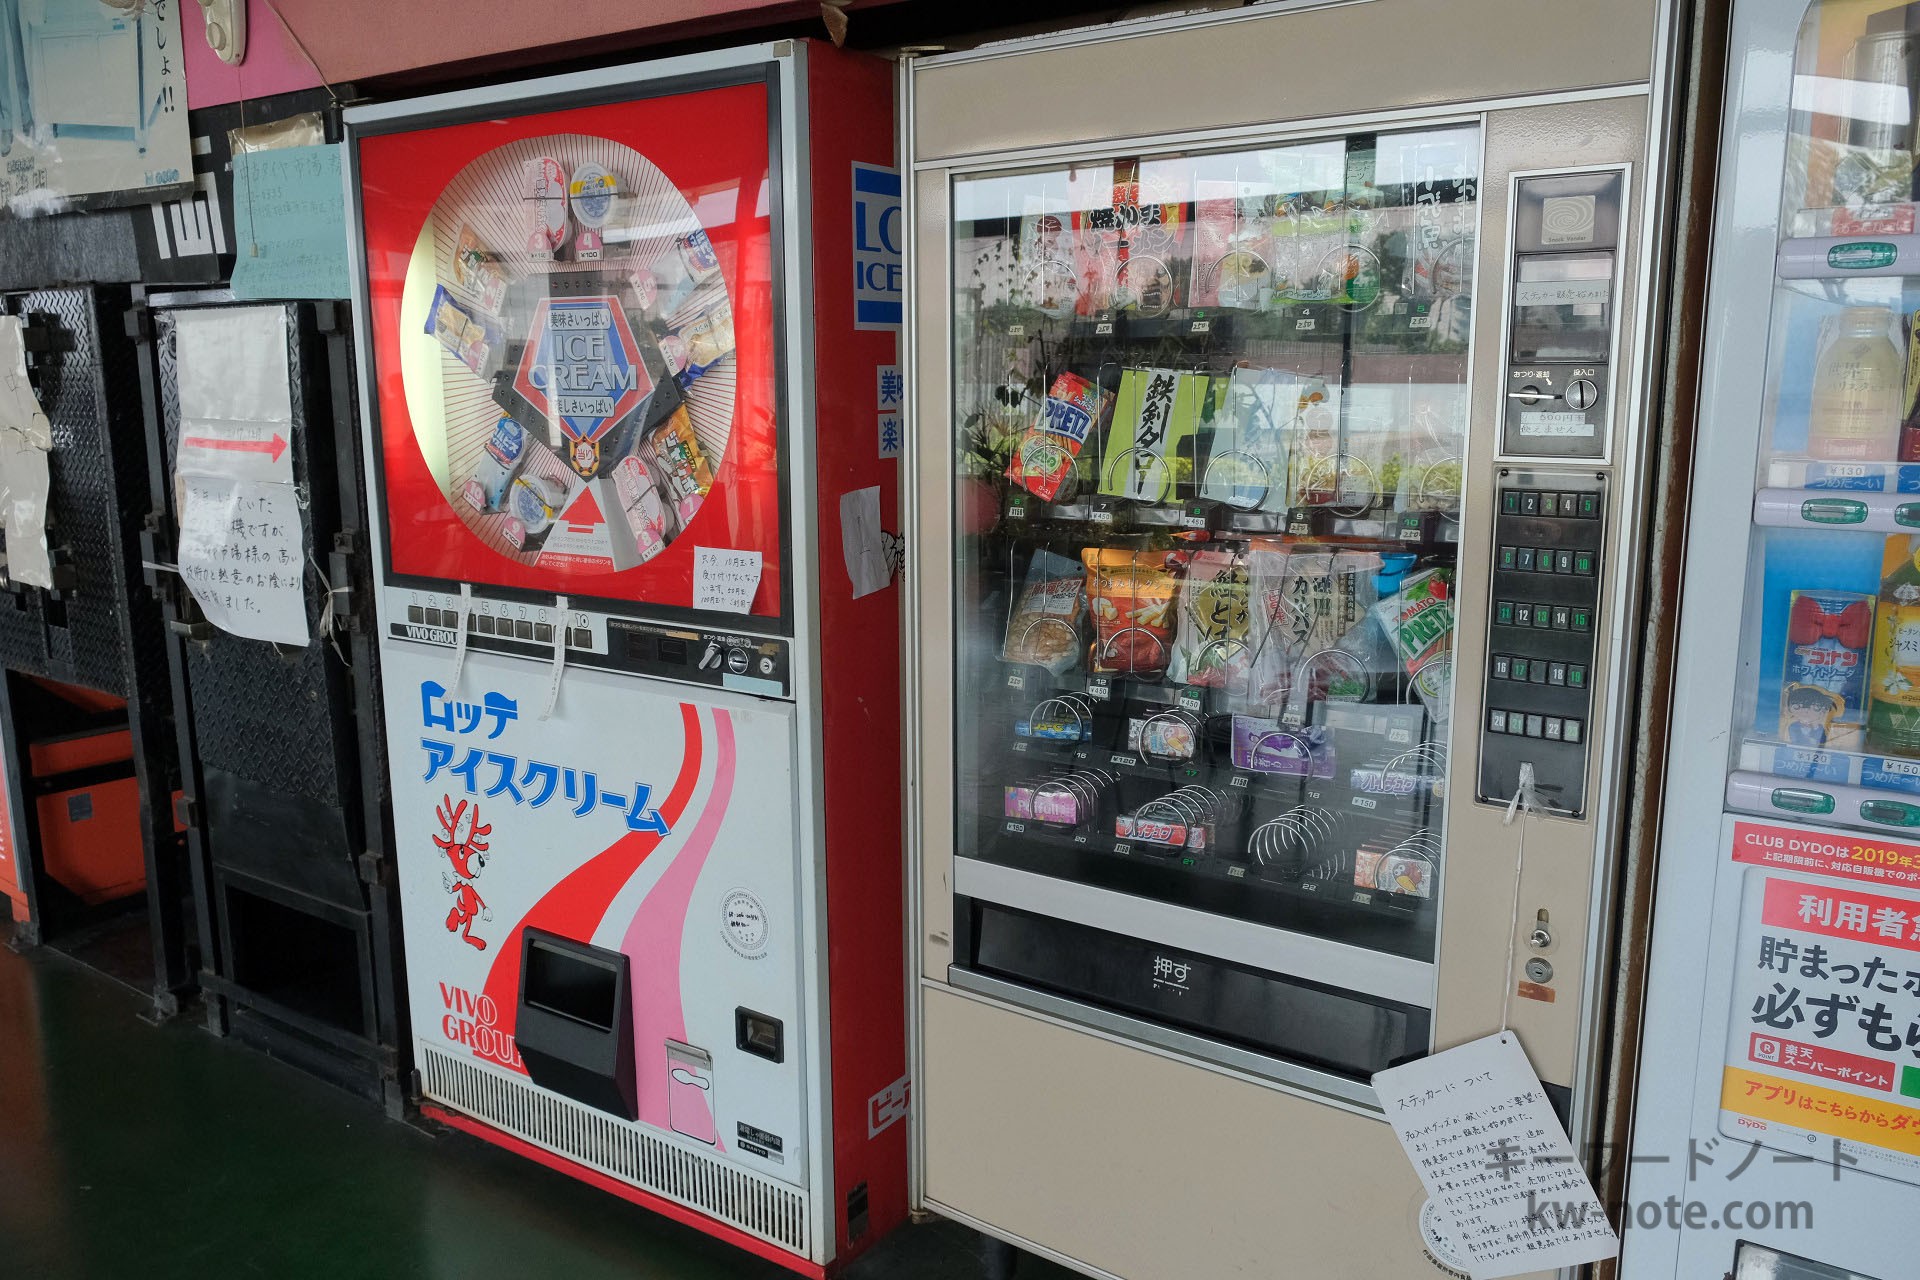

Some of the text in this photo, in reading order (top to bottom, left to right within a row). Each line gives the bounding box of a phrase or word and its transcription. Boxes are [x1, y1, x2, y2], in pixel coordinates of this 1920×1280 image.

[583, 232, 593, 248] 4
[551, 311, 611, 328] 美味さいっぱい
[555, 335, 606, 362] ICE
[528, 363, 638, 391] CREAM
[1573, 368, 1595, 376] 投入口
[1044, 399, 1090, 439] PRETZ
[1830, 466, 1863, 476] ¥130
[685, 497, 695, 513] 7
[1508, 497, 1591, 511] 1 2 3 4 5
[1093, 513, 1111, 521] ¥450
[1186, 518, 1204, 527] ¥450
[1404, 519, 1418, 527] 10
[1504, 553, 1511, 564] 6
[1524, 554, 1530, 565] 7
[1561, 557, 1567, 568] 9
[1578, 559, 1588, 570] 10
[428, 595, 437, 607] 2
[446, 597, 454, 609] 3
[481, 602, 490, 615] 5
[501, 604, 509, 617] 6
[519, 606, 527, 619] 7
[538, 608, 547, 622] 8
[575, 613, 590, 628] 10
[1392, 597, 1437, 623] TOMATO
[1501, 608, 1585, 625] 11 12 13 14 15
[406, 626, 429, 639] VIVO
[1807, 650, 1859, 667] コナン
[1497, 662, 1506, 673] 16
[1554, 669, 1563, 680] 18
[1792, 664, 1855, 678] ホワイトソーダ
[1090, 687, 1107, 696] ¥450
[1188, 690, 1199, 698] 13
[420, 680, 519, 739] ロッテ
[1180, 699, 1199, 708] ¥450
[1494, 716, 1504, 727] 20
[1549, 724, 1559, 735] 22
[1797, 752, 1828, 763] ¥120
[1886, 762, 1919, 775] ¥150
[420, 737, 671, 837] アイスクリーム
[1308, 791, 1320, 799] 18
[1353, 799, 1374, 808] ¥150
[1745, 834, 1784, 849] CLUB
[1302, 883, 1317, 891] 22
[1153, 955, 1192, 983] 押す
[438, 981, 498, 1025] VIVO
[1785, 1044, 1814, 1060] 楽天
[1784, 1055, 1888, 1086] スーパーポイント
[1397, 1071, 1494, 1112] ステッカーに ついて
[1737, 1117, 1768, 1131] DyDo
